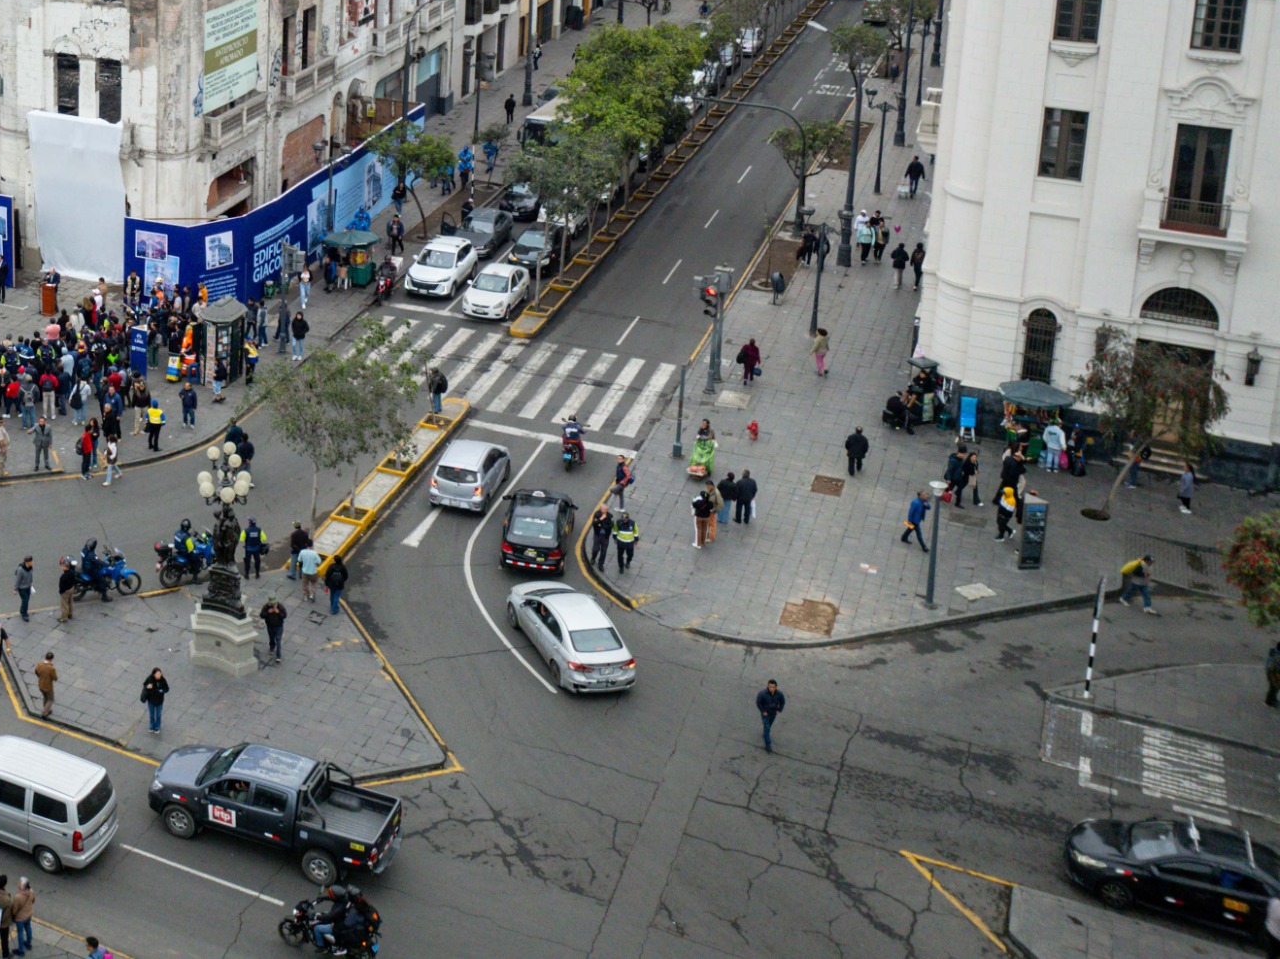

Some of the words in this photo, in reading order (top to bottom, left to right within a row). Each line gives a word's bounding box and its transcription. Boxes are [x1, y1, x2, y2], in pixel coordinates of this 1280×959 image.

[816, 84, 857, 98] SOLO
[253, 234, 290, 268] EDIFICO
[214, 807, 231, 823] irtp
